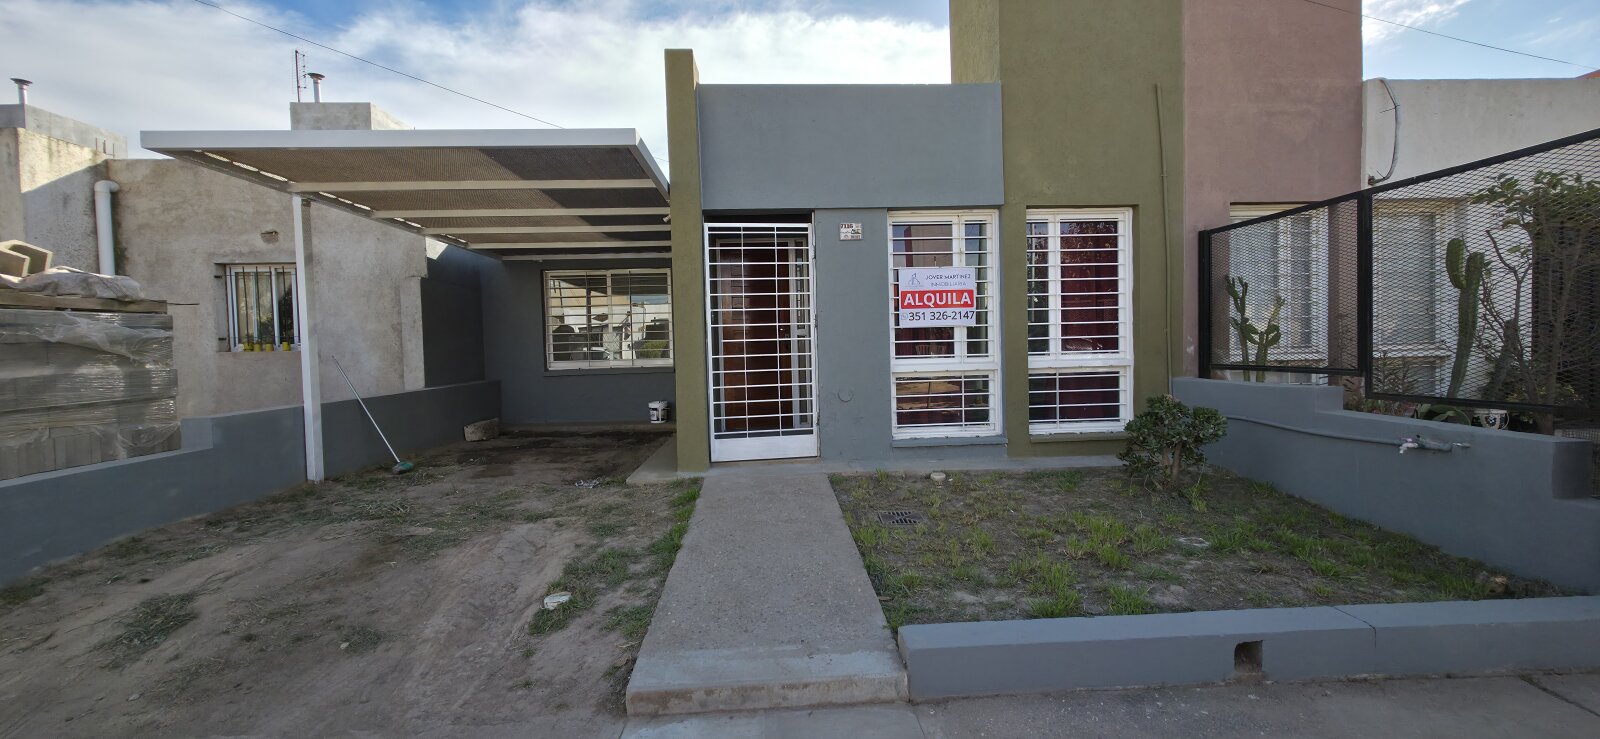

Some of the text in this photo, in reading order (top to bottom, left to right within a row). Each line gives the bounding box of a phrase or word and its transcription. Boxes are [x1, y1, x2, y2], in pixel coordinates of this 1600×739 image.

[904, 292, 971, 307] ALQUILA
[908, 310, 975, 321] 351 326-2147
